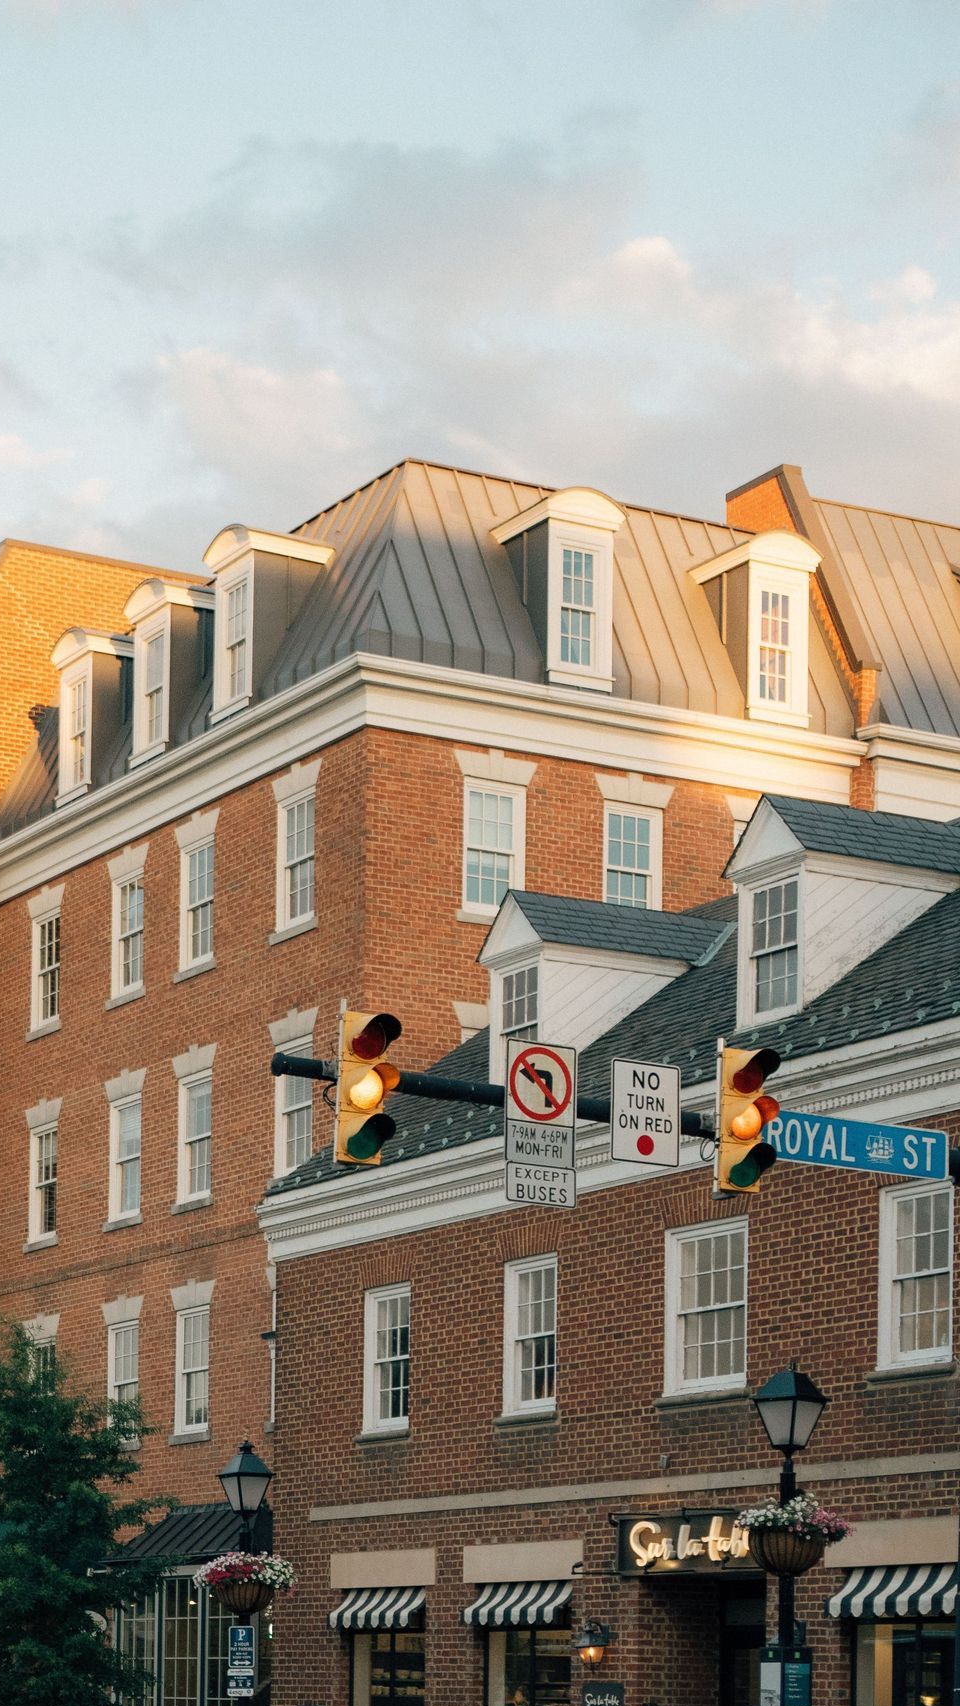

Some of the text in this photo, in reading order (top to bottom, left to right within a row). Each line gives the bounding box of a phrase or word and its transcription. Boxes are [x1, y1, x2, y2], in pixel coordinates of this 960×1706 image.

[633, 1070, 660, 1090] NO
[627, 1093, 664, 1112] TURN
[619, 1114, 672, 1134] ON RED
[512, 1125, 568, 1145] 7-9AM 4-6PM
[767, 1117, 936, 1172] ROYAL ST
[515, 1140, 562, 1159] MON-FRI
[515, 1167, 568, 1184] EXCEPT
[516, 1183, 567, 1204] BUSES
[701, 1516, 750, 1562] tabl
